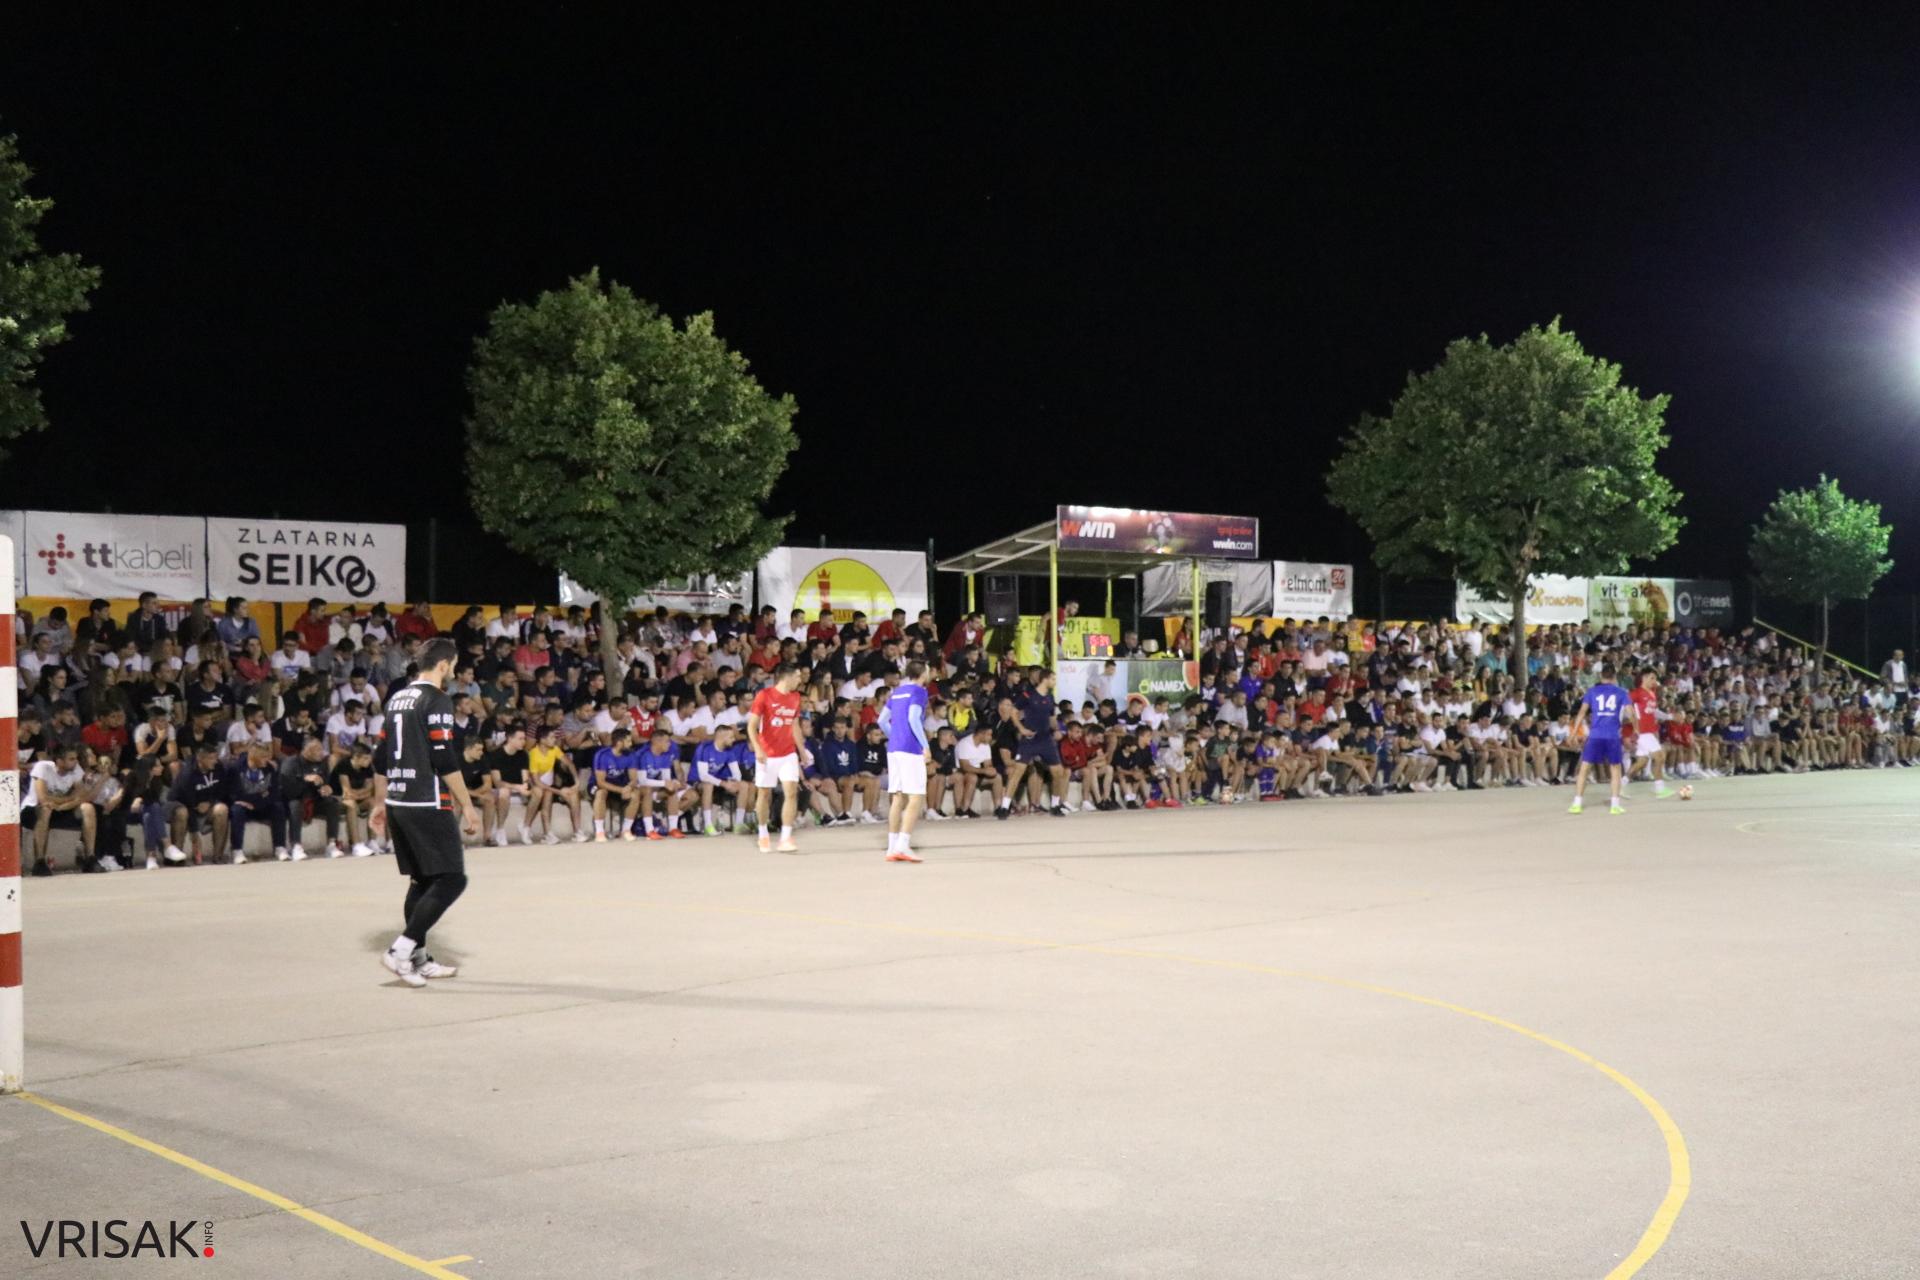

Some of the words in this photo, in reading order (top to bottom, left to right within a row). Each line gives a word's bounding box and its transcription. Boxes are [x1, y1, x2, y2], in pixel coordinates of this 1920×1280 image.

[238, 528, 375, 547] ZLATARNA
[82, 542, 193, 570] ttkabeli
[1151, 680, 1185, 692] NAMEX
[1595, 694, 1616, 711] 14
